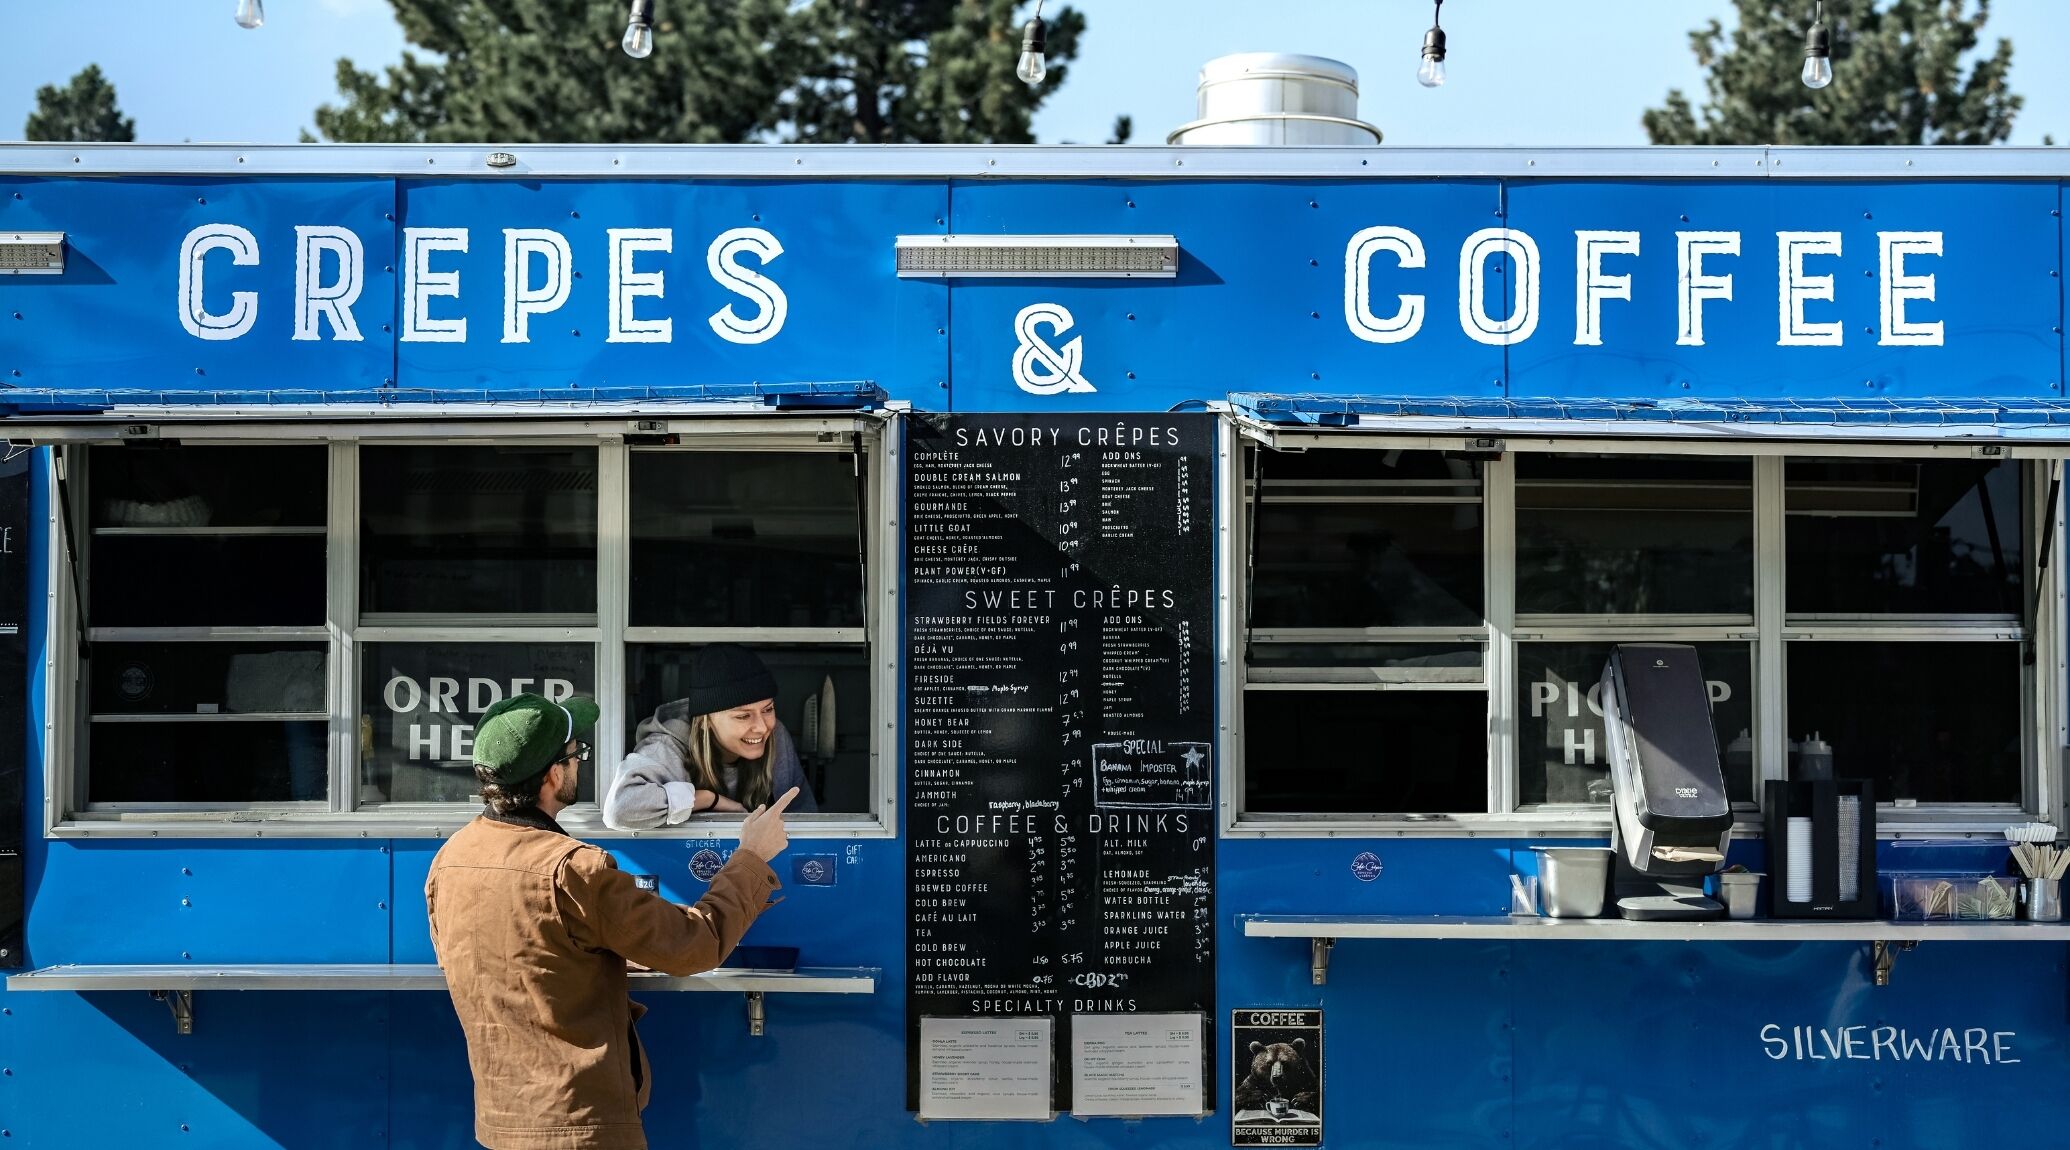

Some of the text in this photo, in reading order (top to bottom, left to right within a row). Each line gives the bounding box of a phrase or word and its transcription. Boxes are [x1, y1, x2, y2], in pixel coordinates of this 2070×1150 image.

[178, 223, 788, 345] CREPES
[1345, 225, 1943, 346] COFFEE
[1012, 303, 1097, 395] &
[956, 421, 1179, 446] SAVORY CRÊPES
[914, 450, 959, 460] COMPLÈTE
[1103, 452, 1141, 460] ADD ONS
[915, 473, 1021, 482] DOUBLE CREAM SALMON
[914, 503, 968, 511] GOURMANDE
[915, 524, 971, 532] LITTLE GOAT
[915, 544, 978, 554] CHEESE CRÊPE
[915, 566, 1006, 576] PLANT POWER(V+GF)
[966, 585, 1174, 609] SWEET CRÊPES
[914, 616, 1050, 625] STRAWBERRY FIELDS FOREVER
[1104, 616, 1142, 624] ADD ONS
[914, 644, 954, 654] DÉJÀ VU
[914, 675, 954, 683] FIRESIDE
[1010, 685, 1029, 694] Syrup
[915, 696, 953, 705] SUZETTE
[409, 724, 474, 760] HE
[914, 740, 962, 748] DARK SIDE
[1123, 739, 1166, 755] SPECIAL
[914, 770, 960, 778] CINNAMON
[915, 791, 957, 799] JAMMOTH
[938, 815, 1189, 834] COFFEE & DRINKS
[686, 839, 721, 849] STICKER
[916, 840, 1009, 848] LATTE CAPPUCCINO
[846, 844, 863, 855] GIFT
[1104, 870, 1150, 878] LEMONADE
[916, 884, 988, 892] BREWED COFFEE
[916, 899, 966, 907] COLD BREW
[1104, 897, 1170, 905] WATER BOTTLE
[916, 911, 938, 922] CAFÉ
[1104, 911, 1186, 920] SPARKLING WATER
[916, 929, 931, 937] TEA
[1104, 926, 1168, 934] ORANGE JUICE
[916, 944, 966, 952] COLD BREW
[1104, 941, 1161, 949] APPLE JUICE
[1104, 956, 1151, 964] KOMBUCHA
[916, 974, 970, 982] ADD FLAVOR
[972, 1000, 1137, 1012] SPECIALTY DRINKS
[1250, 1013, 1305, 1026] COFFEE
[1760, 1023, 2021, 1065] SILVERWARE
[1235, 1128, 1319, 1136] BECAUSE MURDER IS
